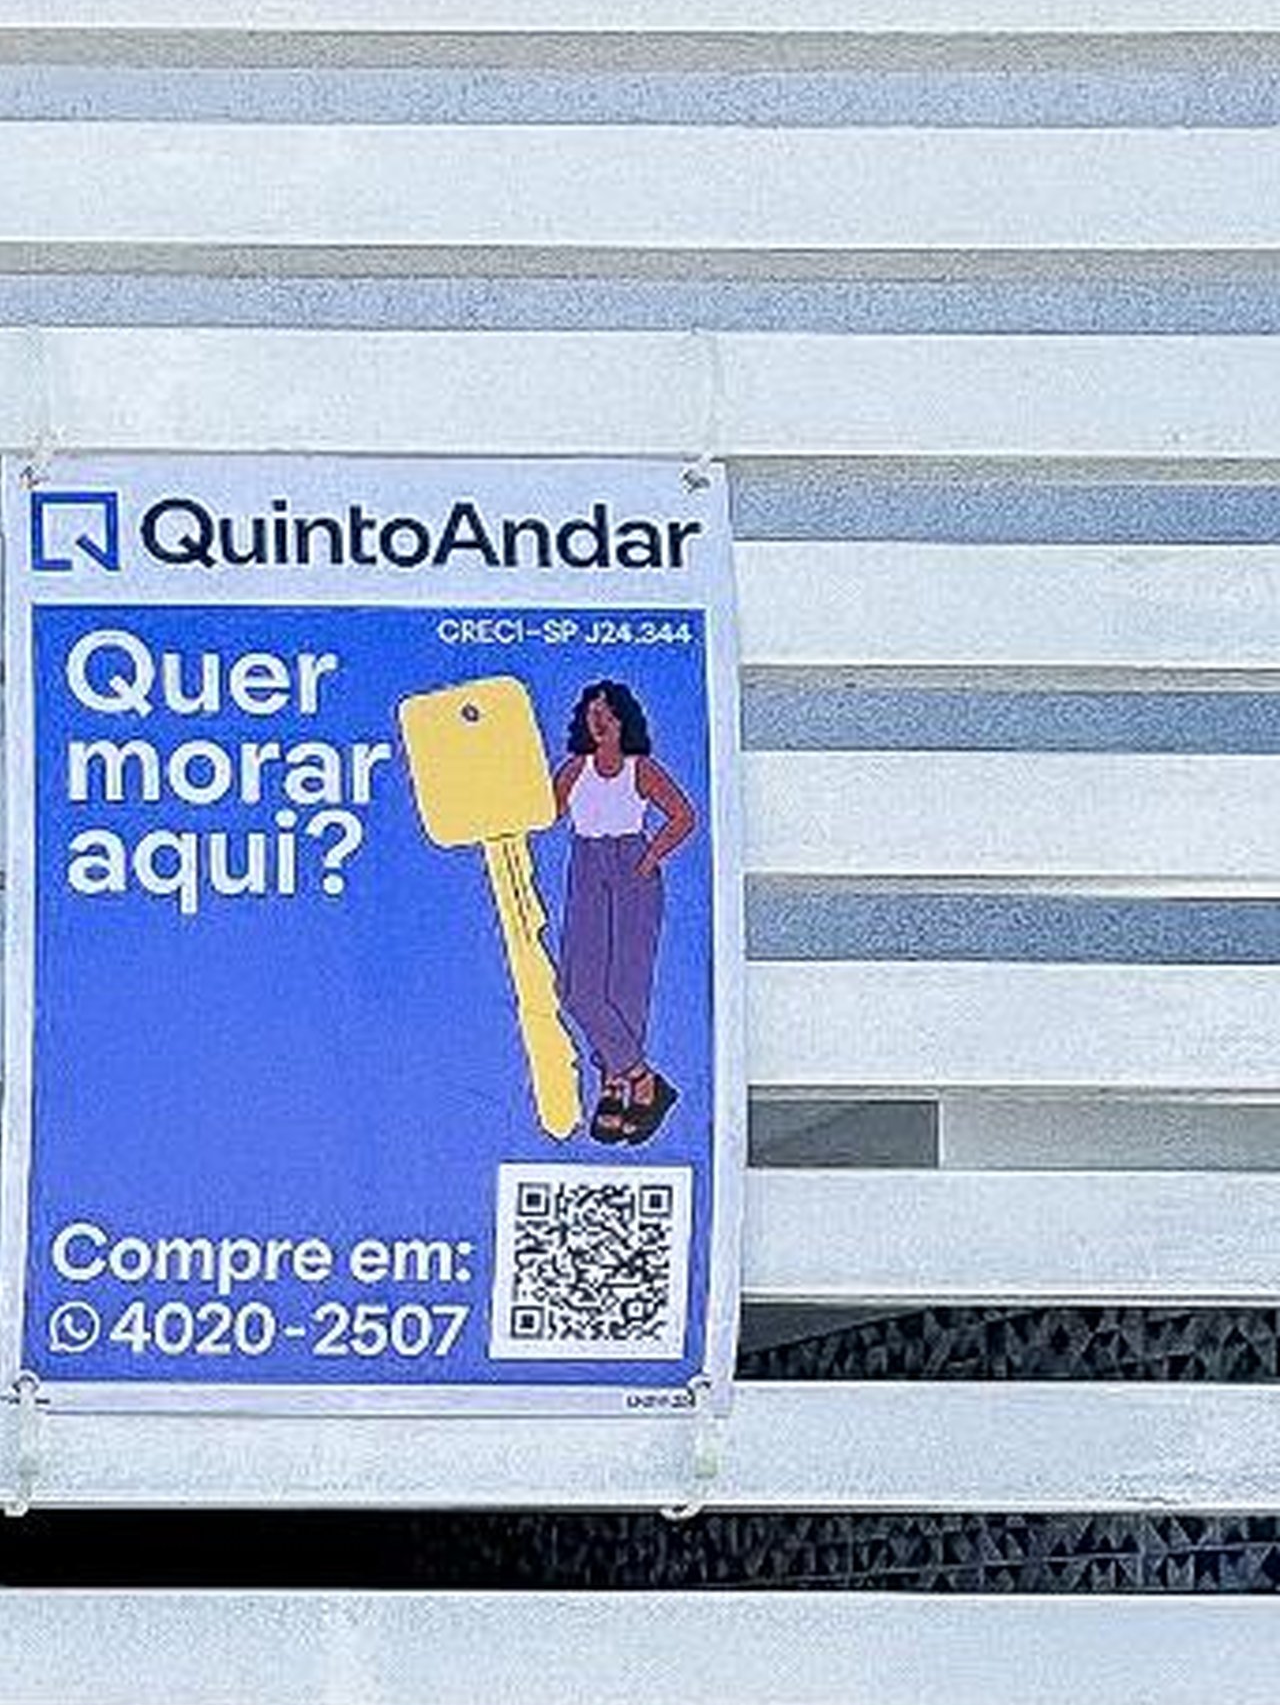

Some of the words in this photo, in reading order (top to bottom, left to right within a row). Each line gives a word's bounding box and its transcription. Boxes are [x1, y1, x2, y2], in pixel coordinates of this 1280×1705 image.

[139, 497, 701, 569] QuintoAndar
[584, 622, 692, 644] J24.344
[65, 630, 338, 720] Quer
[66, 734, 392, 805] morar
[66, 810, 364, 914] aqui?
[50, 1221, 333, 1294] Compre
[349, 1234, 474, 1283] em:
[109, 1302, 471, 1358] 4020-2507
